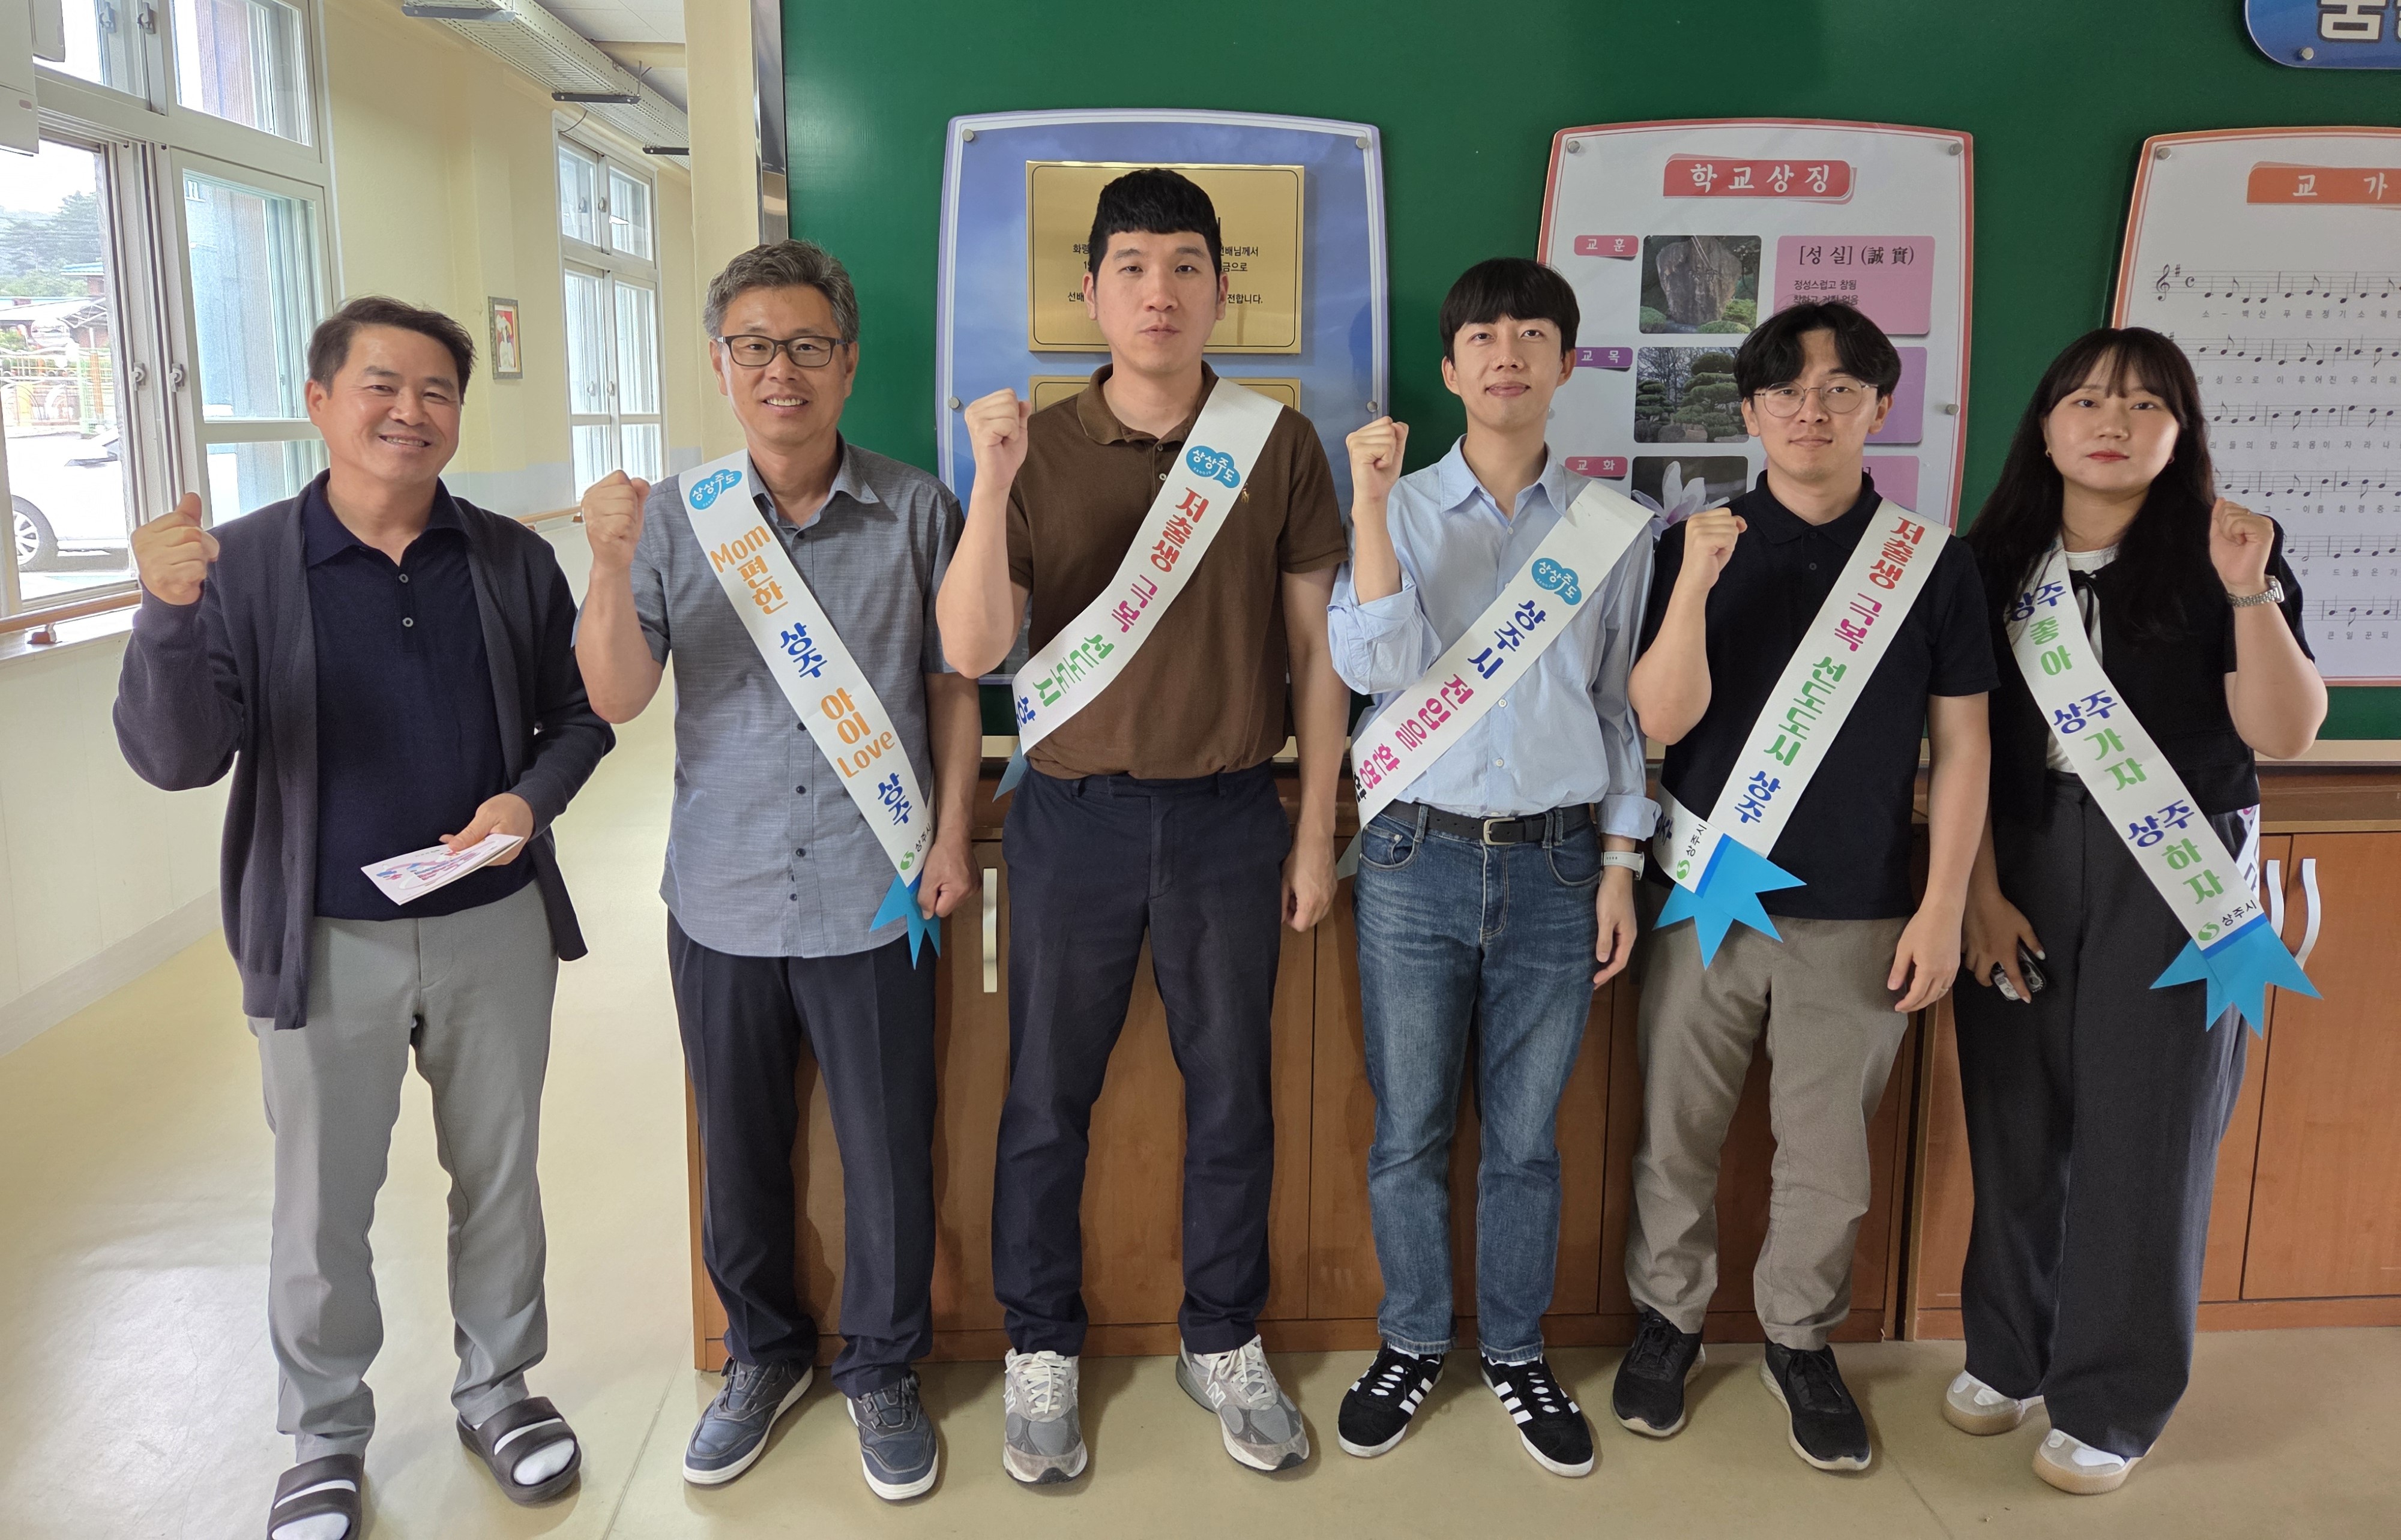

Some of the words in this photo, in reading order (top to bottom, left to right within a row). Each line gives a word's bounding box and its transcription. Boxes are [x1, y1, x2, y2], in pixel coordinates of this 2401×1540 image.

[1690, 164, 1830, 193] 학교상징
[1226, 293, 1264, 305] 전합니다.
[1794, 279, 1837, 291] 정성스럽고
[1839, 279, 1858, 291] 참됨
[1150, 485, 1210, 573] 저출생
[1868, 516, 1926, 590] 저출생
[1112, 574, 1158, 633] 극복
[1833, 592, 1883, 652] 극복
[2011, 580, 2066, 622] 상주
[780, 621, 828, 679] 상주
[1468, 600, 1546, 680] 상주시
[2030, 616, 2073, 676] 좋아
[1032, 634, 1115, 707] 선도도시
[1017, 695, 1036, 731] 상
[1395, 673, 1474, 752] 전입을
[1764, 656, 1848, 766] 선도도시
[2053, 690, 2118, 735] 상주
[2084, 727, 2147, 792] 가자
[877, 772, 913, 826] 상주
[1734, 770, 1781, 824] 상주
[2128, 799, 2195, 848] 상주
[915, 822, 932, 852] 상주시
[1686, 823, 1708, 857] 상주시
[2162, 838, 2226, 905] 하자
[2222, 899, 2257, 927] 상주시
